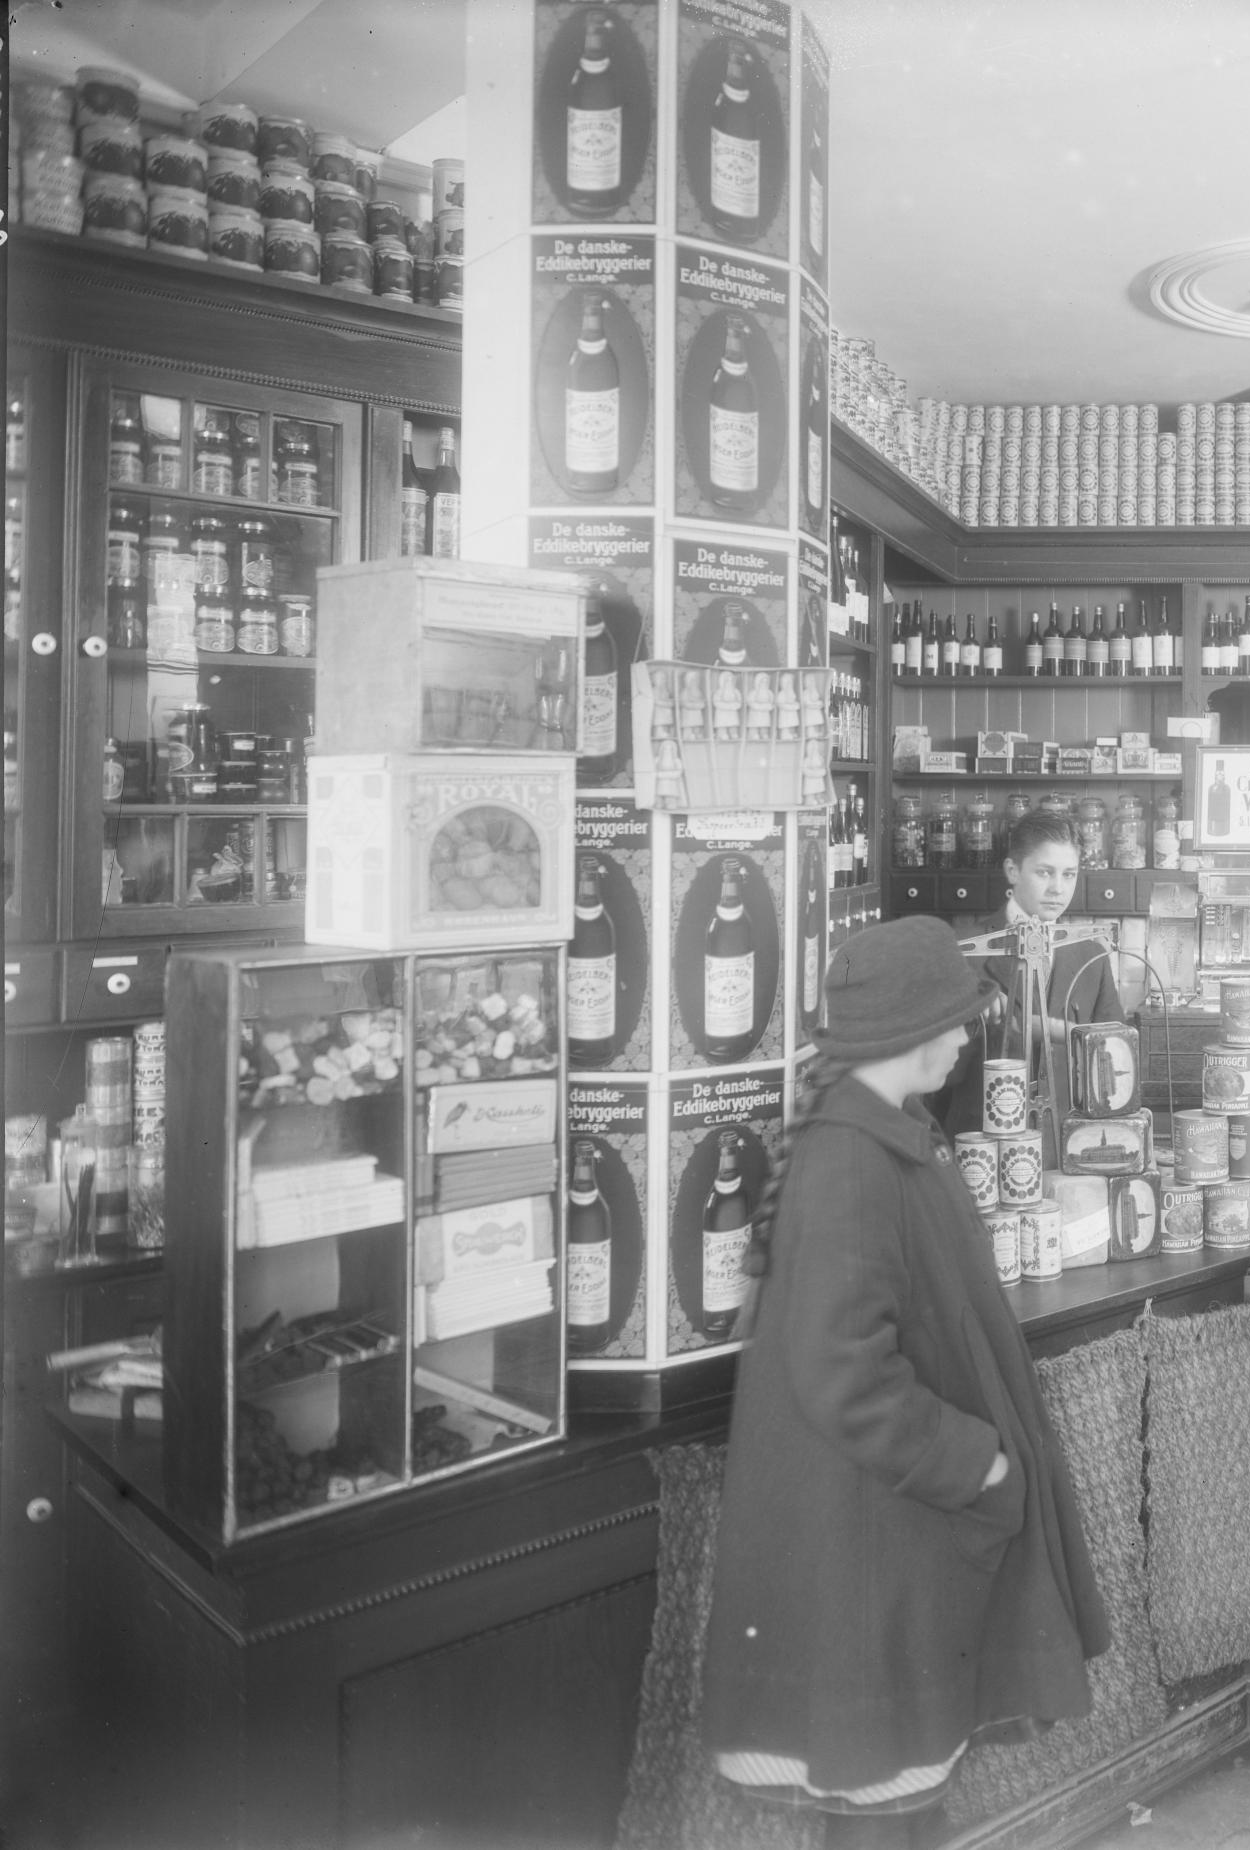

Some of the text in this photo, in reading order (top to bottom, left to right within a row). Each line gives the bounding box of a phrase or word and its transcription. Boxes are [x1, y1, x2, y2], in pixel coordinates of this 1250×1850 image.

[554, 240, 574, 255] De
[535, 255, 652, 276] Eddikebryggerier
[698, 256, 717, 272] De
[679, 269, 787, 306] Eddikebryggerier
[551, 522, 572, 537] De
[533, 537, 651, 557] Eddikebryggerier
[696, 548, 716, 563] De
[678, 562, 785, 587] Eddikebryggerier
[1203, 1052, 1248, 1068] OUTRIGGER
[692, 1084, 711, 1098] De
[673, 1090, 782, 1117] Eddikebryggerier
